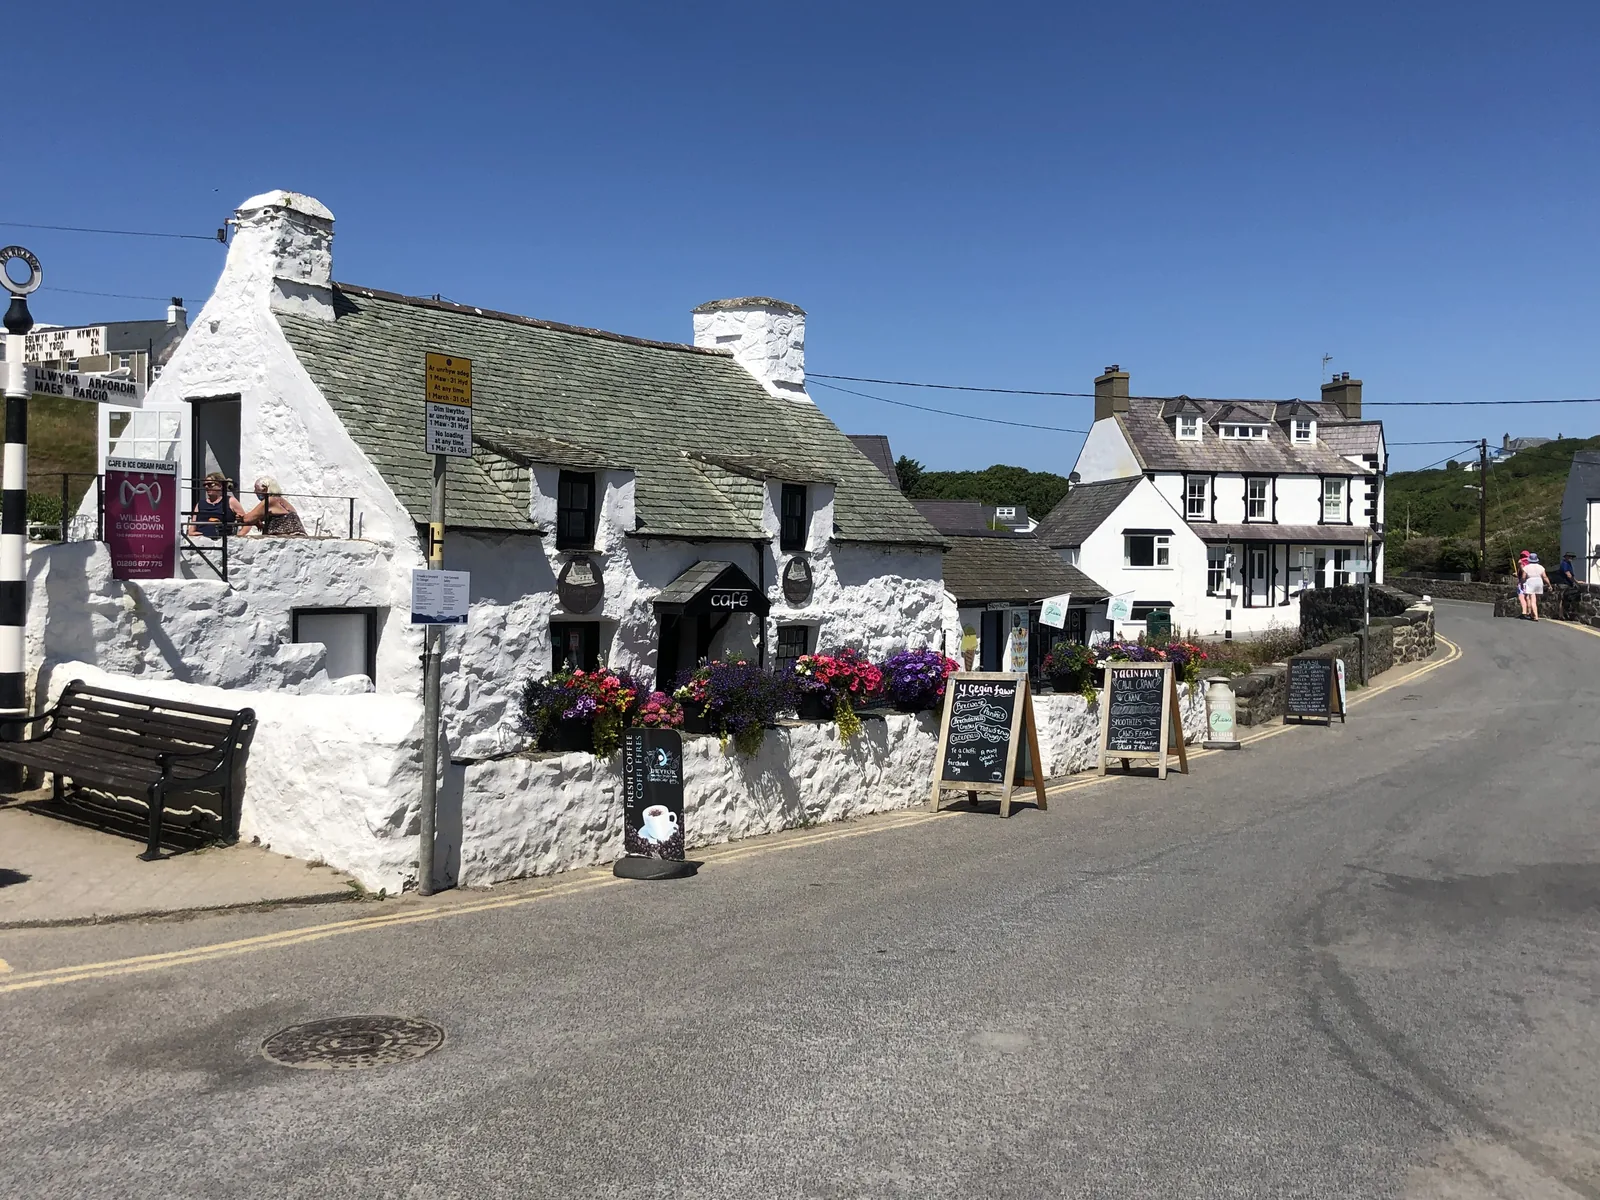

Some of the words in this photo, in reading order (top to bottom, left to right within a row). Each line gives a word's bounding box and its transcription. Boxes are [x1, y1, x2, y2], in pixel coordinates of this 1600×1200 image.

[24, 334, 48, 345] EGLWYS
[54, 332, 69, 341] SANT
[77, 328, 100, 339] HYWYN
[25, 343, 43, 352] PORTH
[25, 353, 40, 362] PLAS
[60, 348, 75, 359] RHIW
[436, 366, 455, 375] unrhyw
[457, 370, 469, 378] adeg
[34, 368, 78, 386] LLWYBR
[88, 376, 136, 394] ARFORDIR
[34, 380, 64, 394] MAES
[73, 387, 108, 402] PARCIO
[446, 406, 465, 415] llwytho
[445, 431, 463, 440] loading
[137, 461, 154, 470] CREAM
[120, 514, 160, 522] WILLIAMS
[124, 523, 164, 531] GOODWIN
[711, 592, 748, 609] café
[1117, 680, 1133, 690] CAWL
[1136, 679, 1157, 690] CRANC
[1112, 718, 1142, 726] SMOOTHIES
